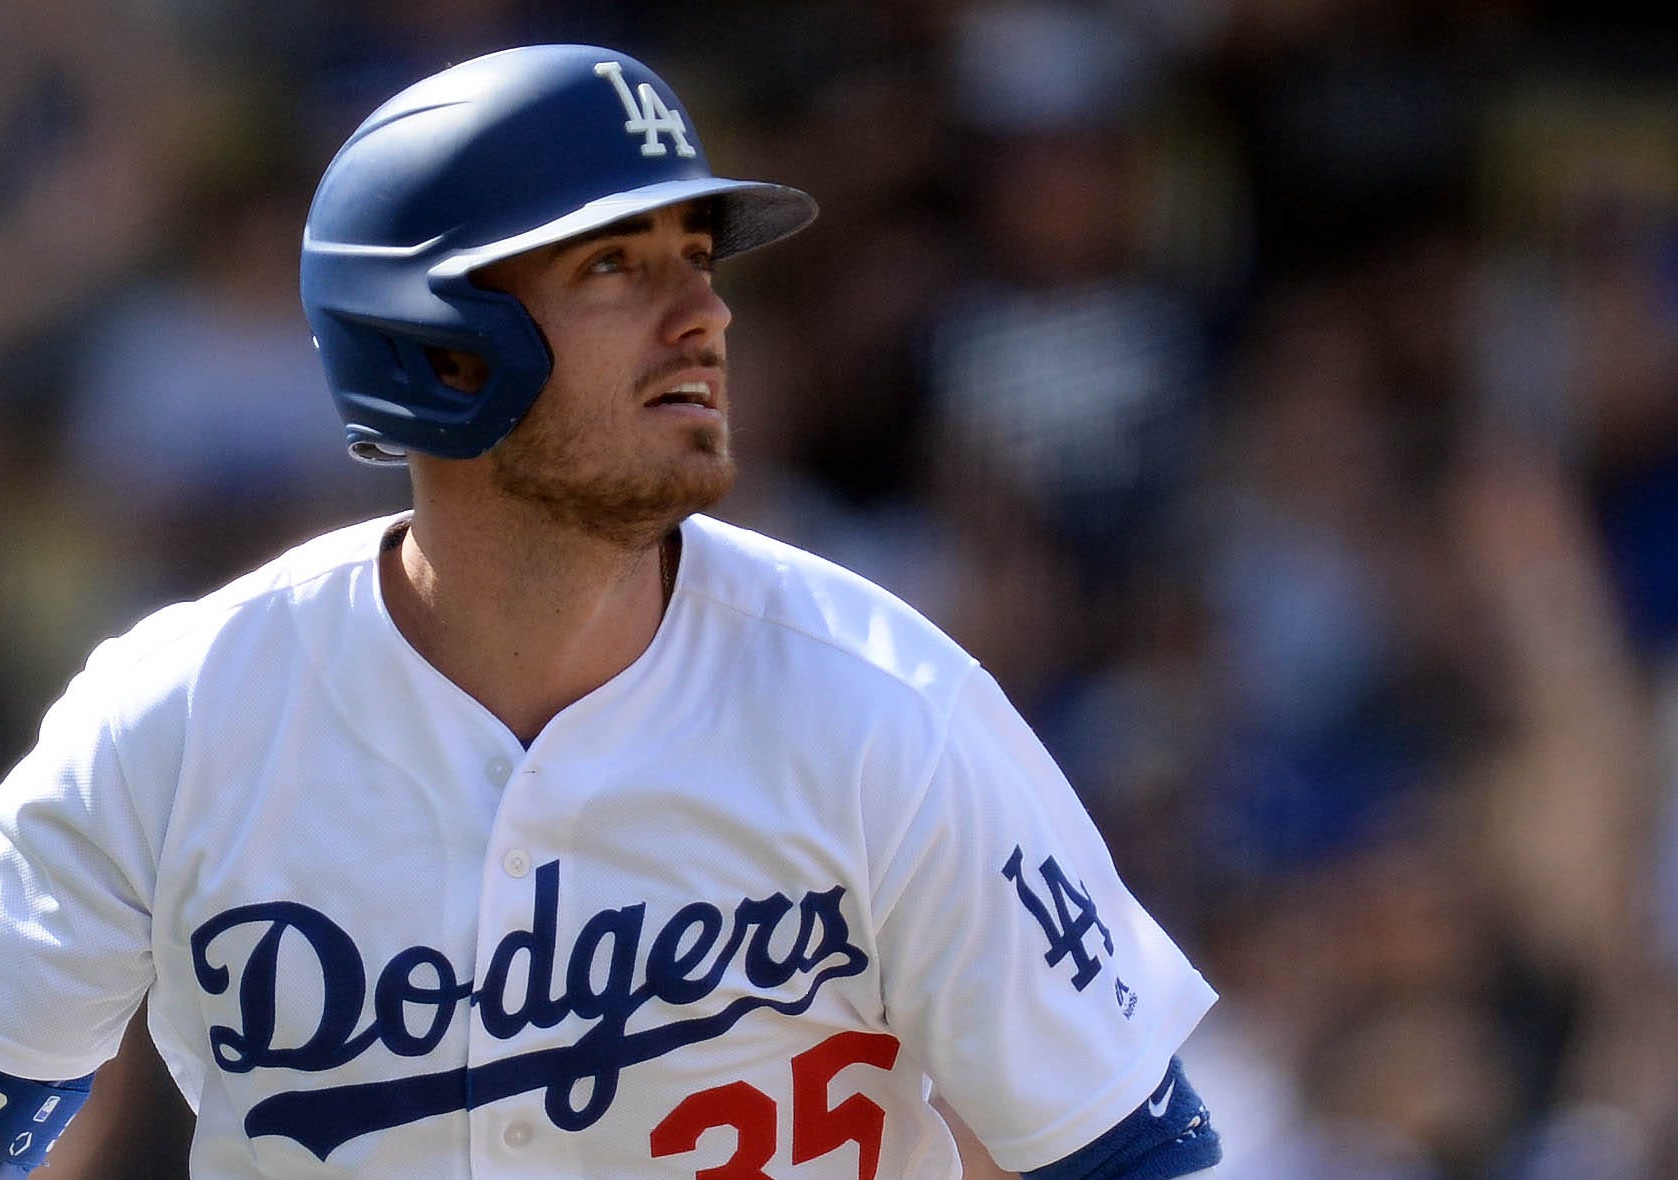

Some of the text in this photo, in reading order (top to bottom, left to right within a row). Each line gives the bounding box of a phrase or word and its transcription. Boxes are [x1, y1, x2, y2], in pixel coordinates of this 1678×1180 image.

[594, 61, 696, 158] LA
[1001, 843, 1115, 993] LA
[190, 859, 869, 1132] Dodgers
